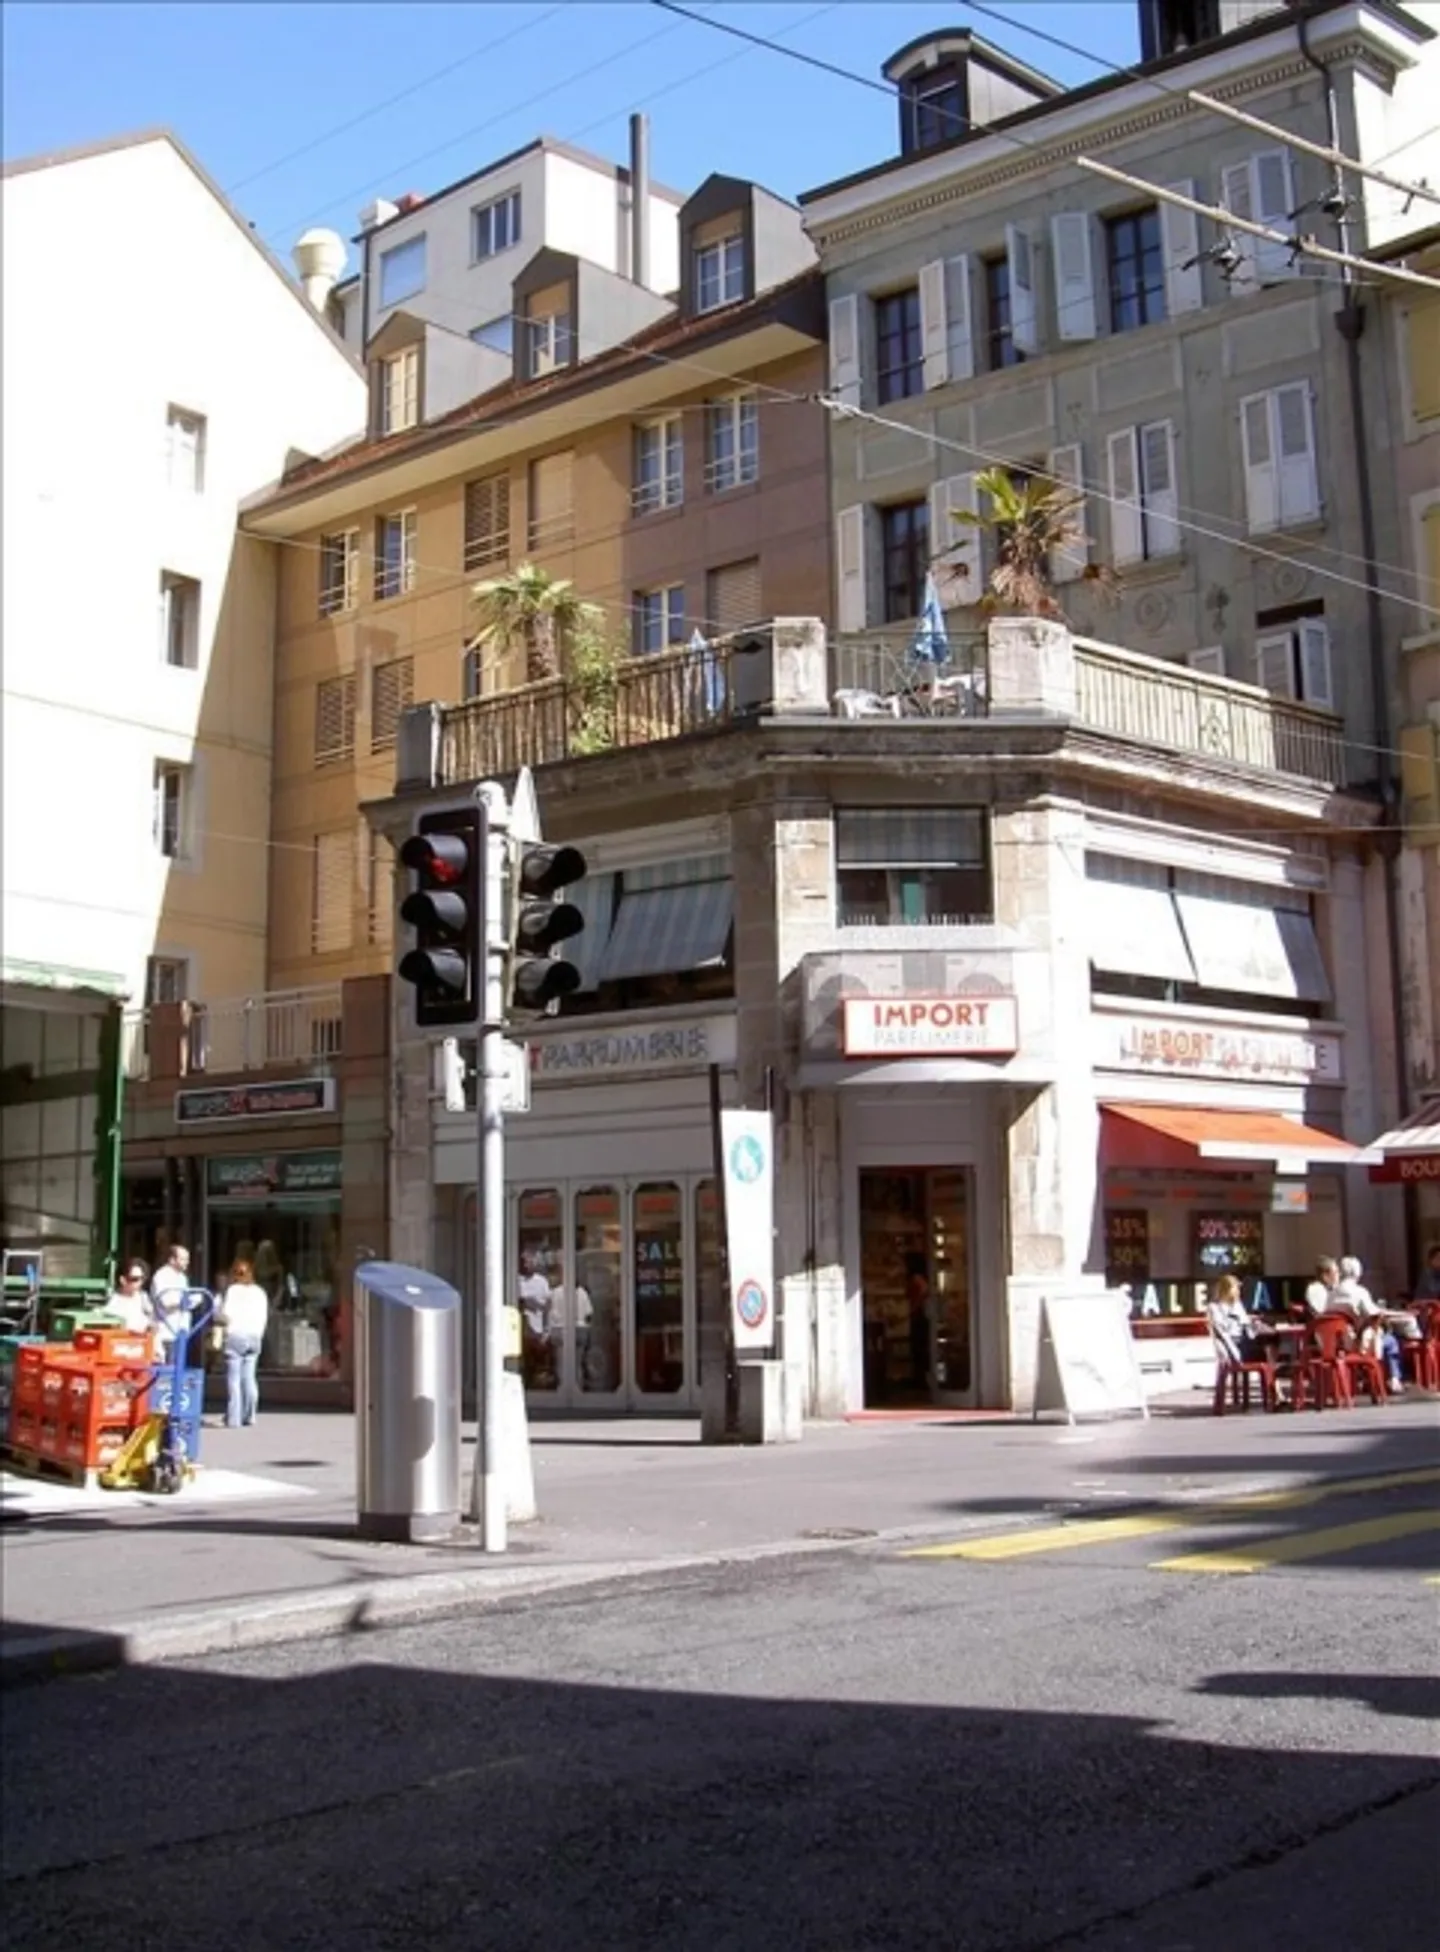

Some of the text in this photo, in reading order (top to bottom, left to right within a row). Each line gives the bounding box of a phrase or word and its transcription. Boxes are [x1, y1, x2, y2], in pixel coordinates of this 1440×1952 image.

[873, 1002, 989, 1028] IMPORT
[873, 1029, 989, 1047] PARFUMERIE
[1131, 1025, 1214, 1056] IMPORT
